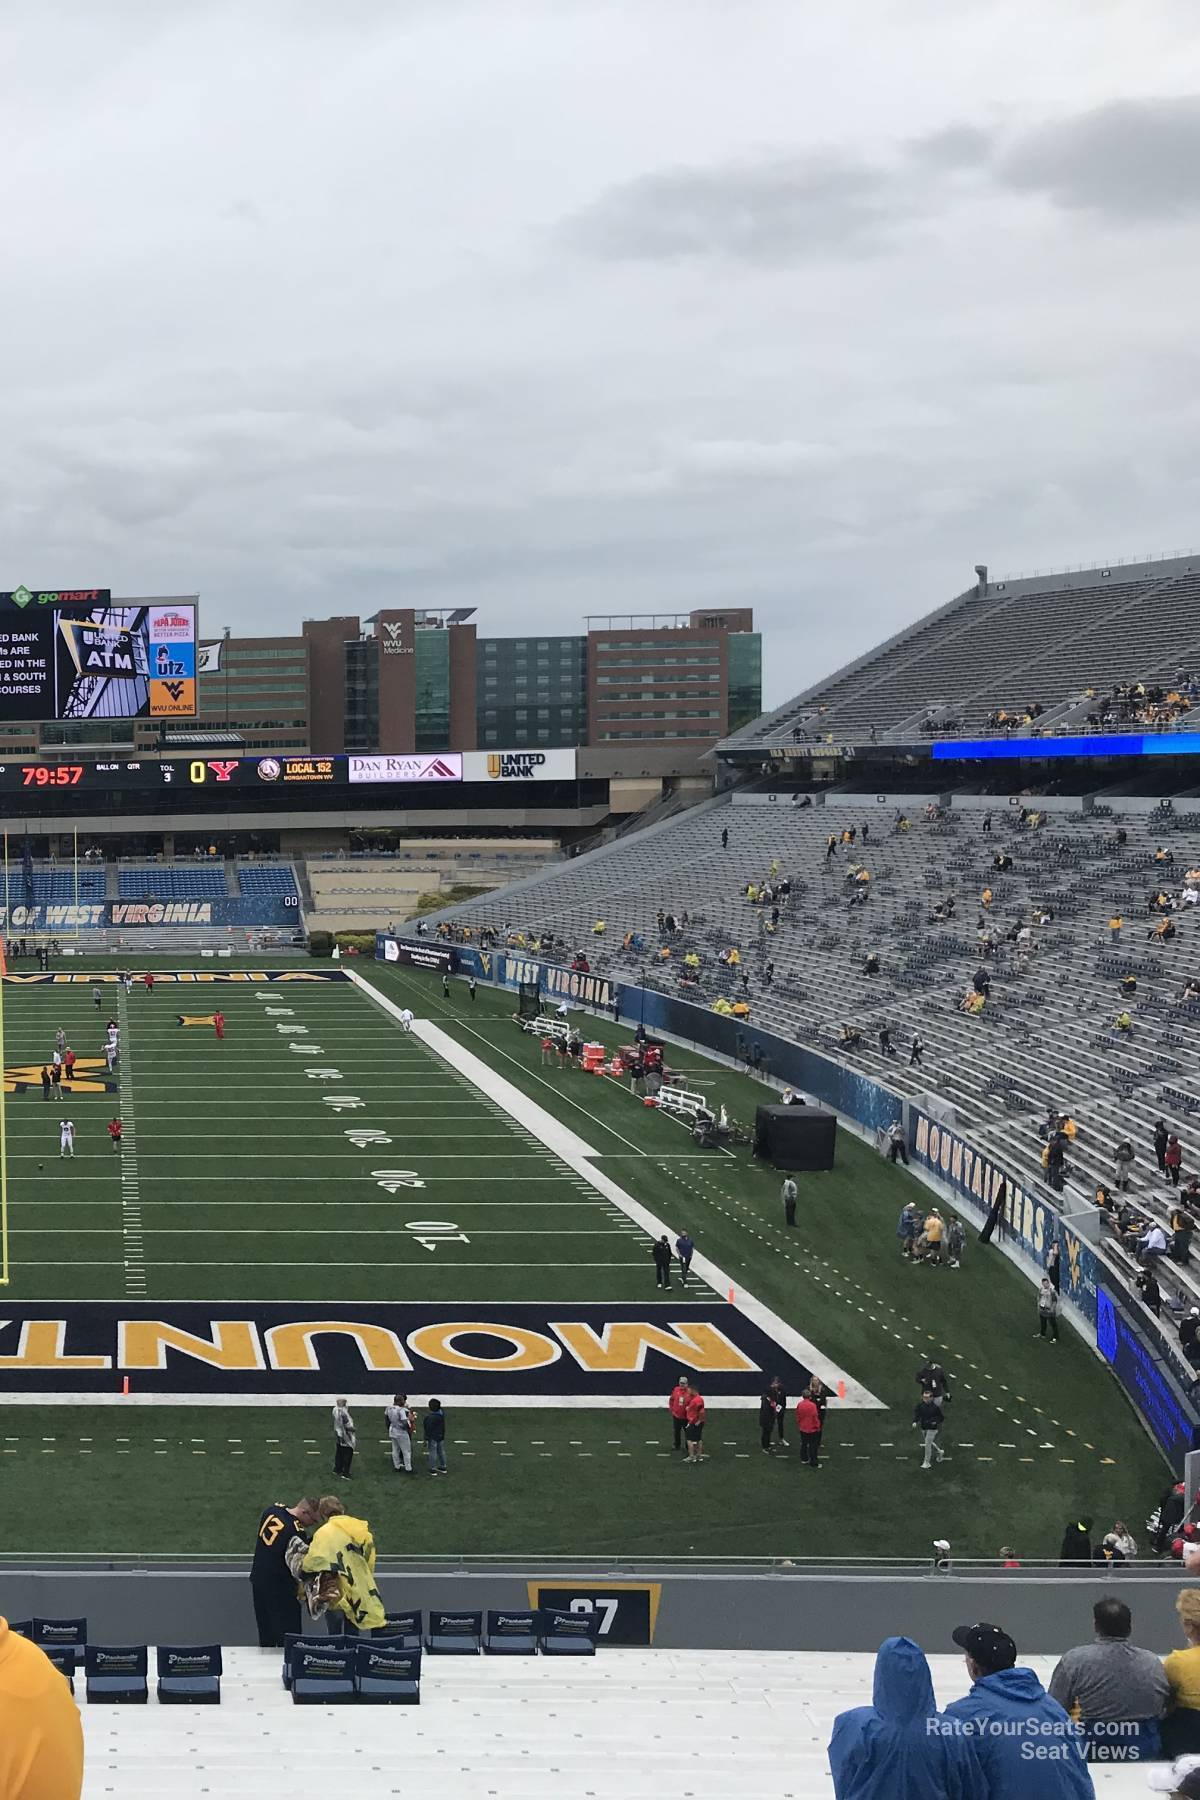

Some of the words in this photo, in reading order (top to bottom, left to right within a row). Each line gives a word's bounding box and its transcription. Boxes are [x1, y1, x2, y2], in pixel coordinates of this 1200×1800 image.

[38, 589, 98, 604] gomart
[11, 633, 39, 642] BANK
[94, 638, 121, 648] BANK
[10, 646, 30, 655] ARE
[384, 646, 414, 654] Medicine
[14, 659, 25, 668] IN
[26, 659, 46, 667] THE
[86, 651, 133, 670] ATM
[3, 673, 11, 681] &
[12, 672, 46, 681] SOUTH
[352, 759, 381, 772] DAN
[386, 758, 422, 770] RYAN
[501, 753, 545, 765] UNITED
[190, 761, 205, 783] 0
[286, 763, 315, 774] LOCAL
[316, 762, 332, 773] 152
[501, 765, 533, 777] BANK
[21, 767, 83, 785] 79:57
[163, 773, 171, 782] 3
[11, 905, 41, 926] OF
[46, 905, 104, 925] WEST
[111, 902, 213, 924] VIRGINIA
[1, 971, 332, 983] VIRGINIA
[505, 958, 539, 984] WEST
[547, 968, 610, 1003] VIRGINIA
[370, 1169, 427, 1188] 20
[915, 1115, 1045, 1251] MOUNTAINEERS
[404, 1221, 471, 1244] 10
[259, 1514, 285, 1546] 13
